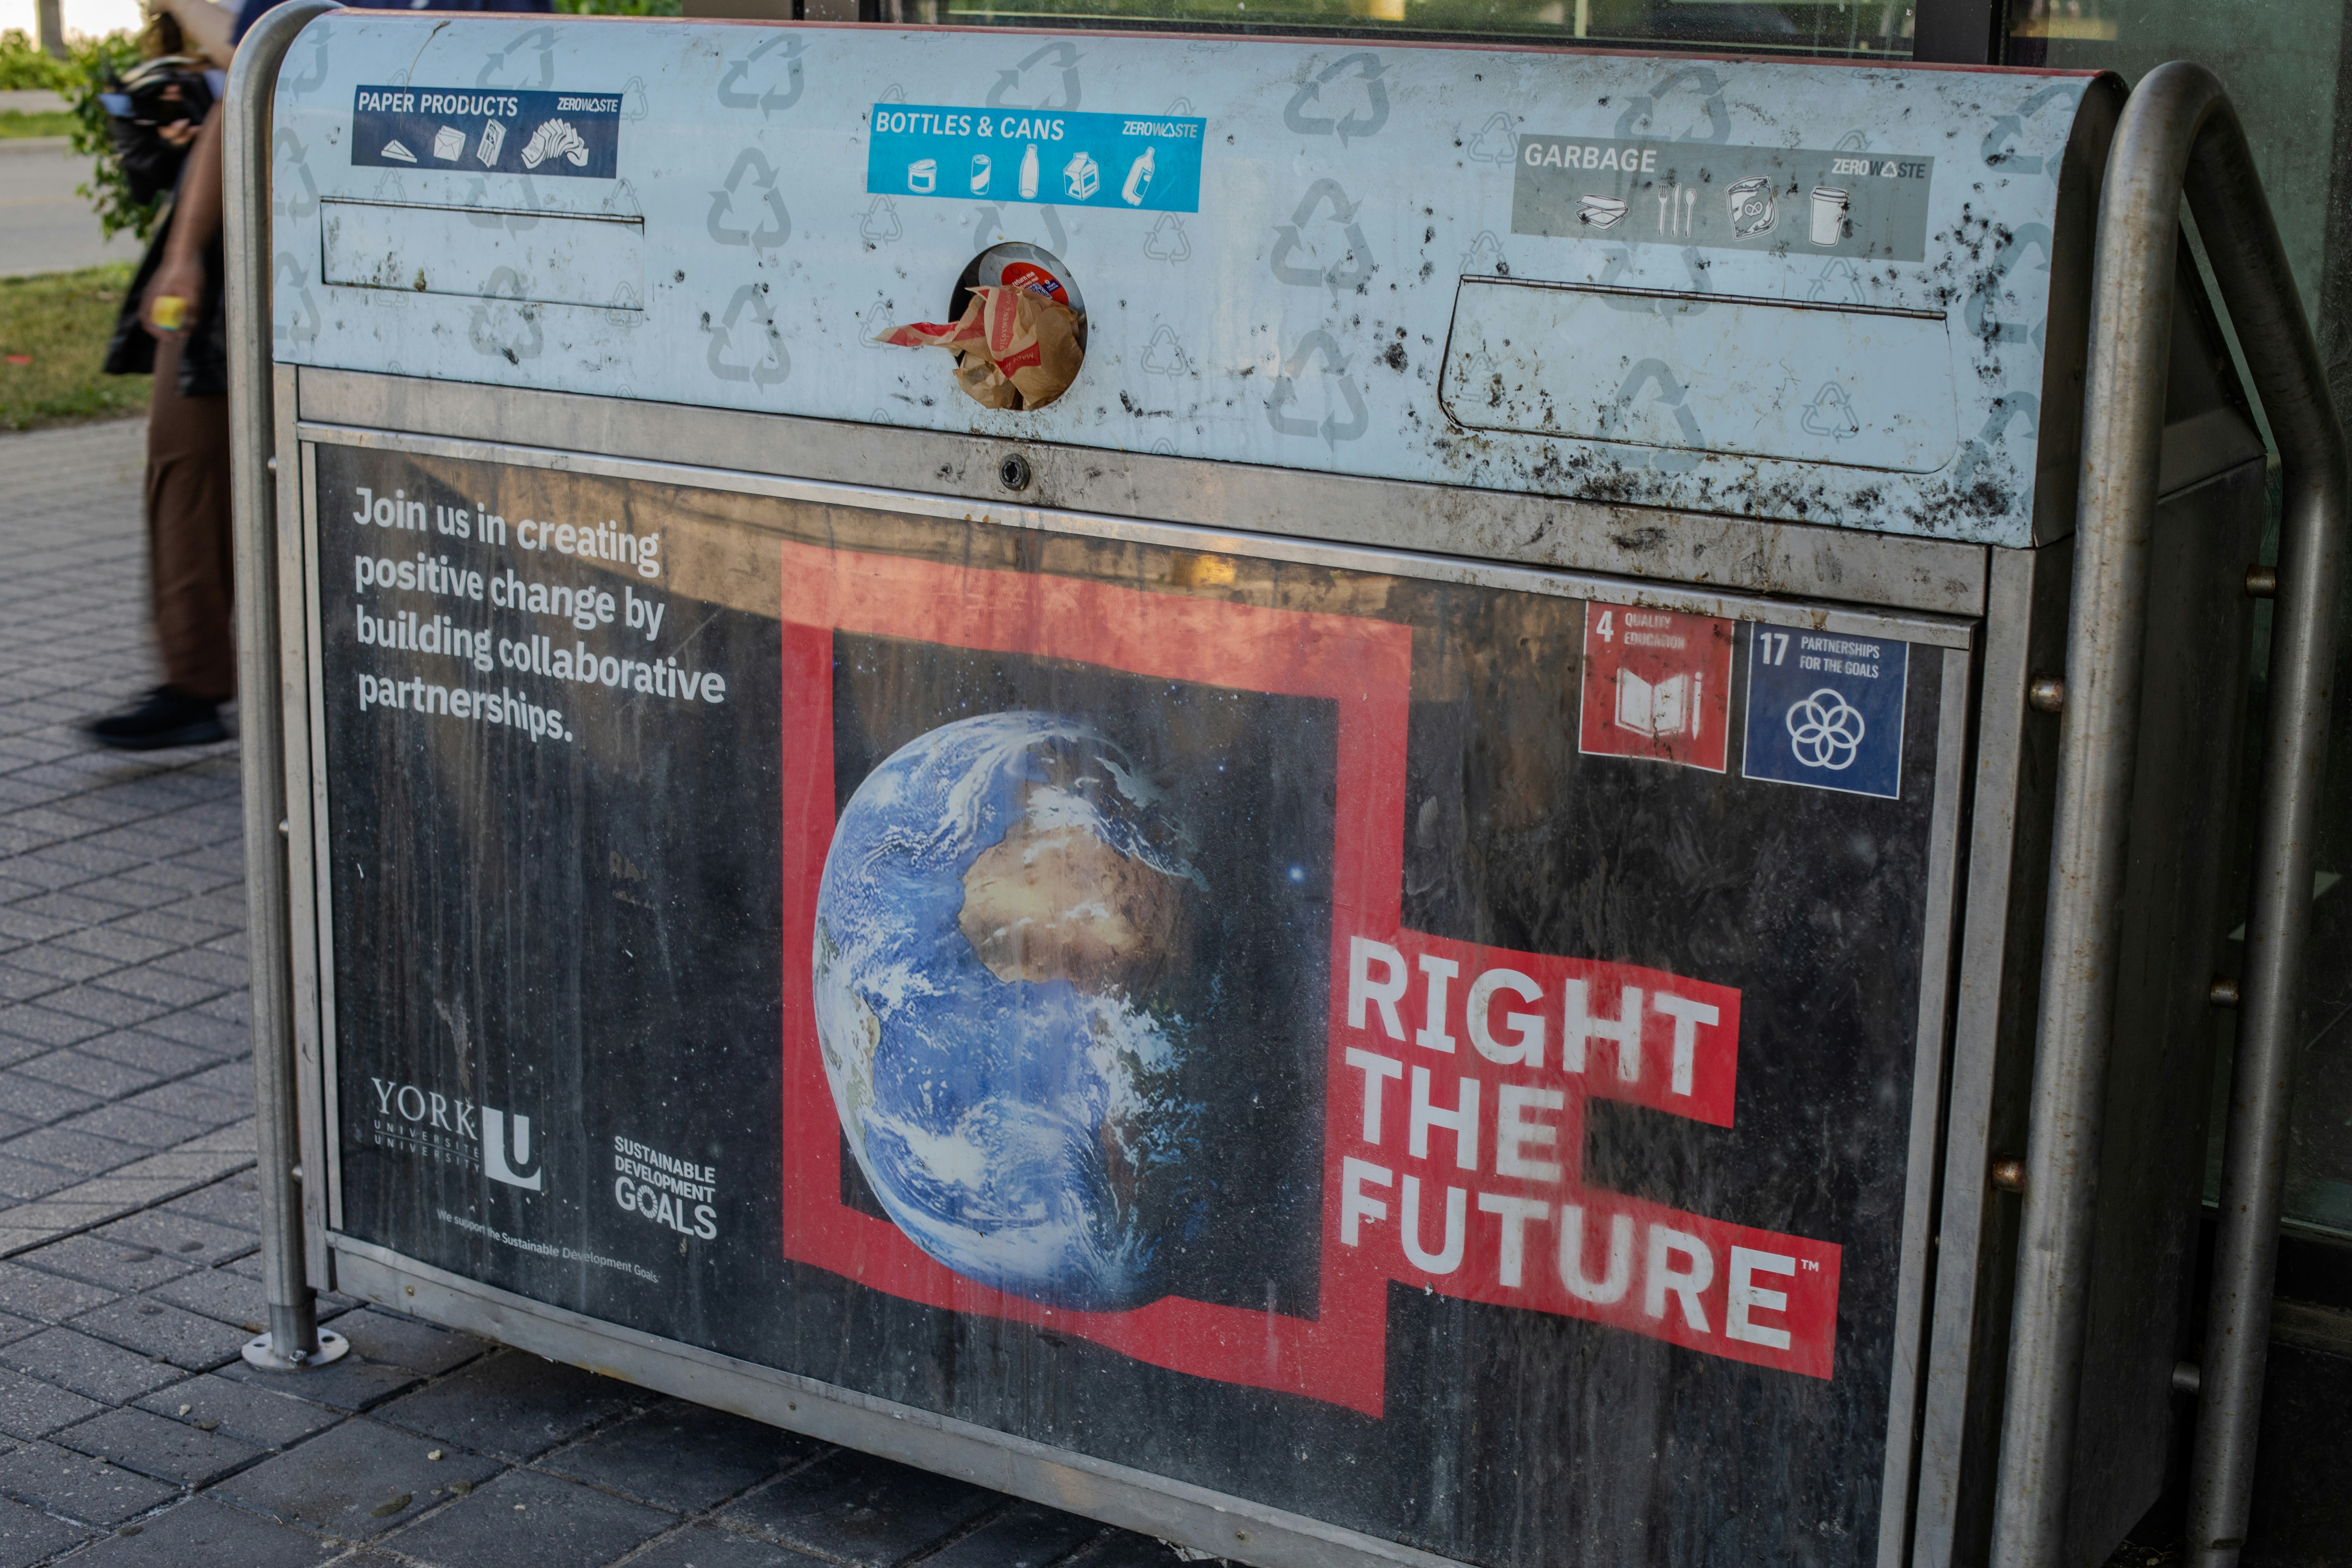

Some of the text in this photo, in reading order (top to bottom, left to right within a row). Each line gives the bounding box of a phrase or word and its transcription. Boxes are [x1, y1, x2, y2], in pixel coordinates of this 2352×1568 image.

[358, 92, 518, 117] PAPER PRODUCTS
[876, 111, 1065, 141] BOTTLES & CANS
[1524, 143, 1657, 173] GARBAGE
[1012, 275, 1028, 286] return
[1020, 276, 1039, 288] turnez-moi
[353, 487, 660, 578] Join us in creating
[355, 551, 665, 641] positive change by
[1596, 610, 1671, 643] 4 QUALITY
[1624, 631, 1686, 650] EDUCATION
[357, 604, 726, 704] building collaborative
[1760, 632, 1880, 666] 17 PARTNERSHIPS
[1799, 656, 1879, 678] FOR THE GOALS
[358, 673, 574, 743] partnerships.
[1347, 935, 1720, 1097] RIGHT
[371, 1077, 478, 1141] YORK
[1346, 1047, 1565, 1183] THE
[374, 1119, 479, 1159] UNIVERSITÉ
[374, 1134, 480, 1173] UNIVERSITY
[614, 1136, 716, 1185] SUSTAINABLE
[614, 1155, 716, 1204] DEVELOPMENT
[614, 1175, 717, 1240] GOALS
[436, 1208, 452, 1222] We
[453, 1216, 486, 1234] support
[487, 1227, 501, 1241] the
[502, 1232, 560, 1257] Sustainable
[562, 1247, 632, 1273] Development
